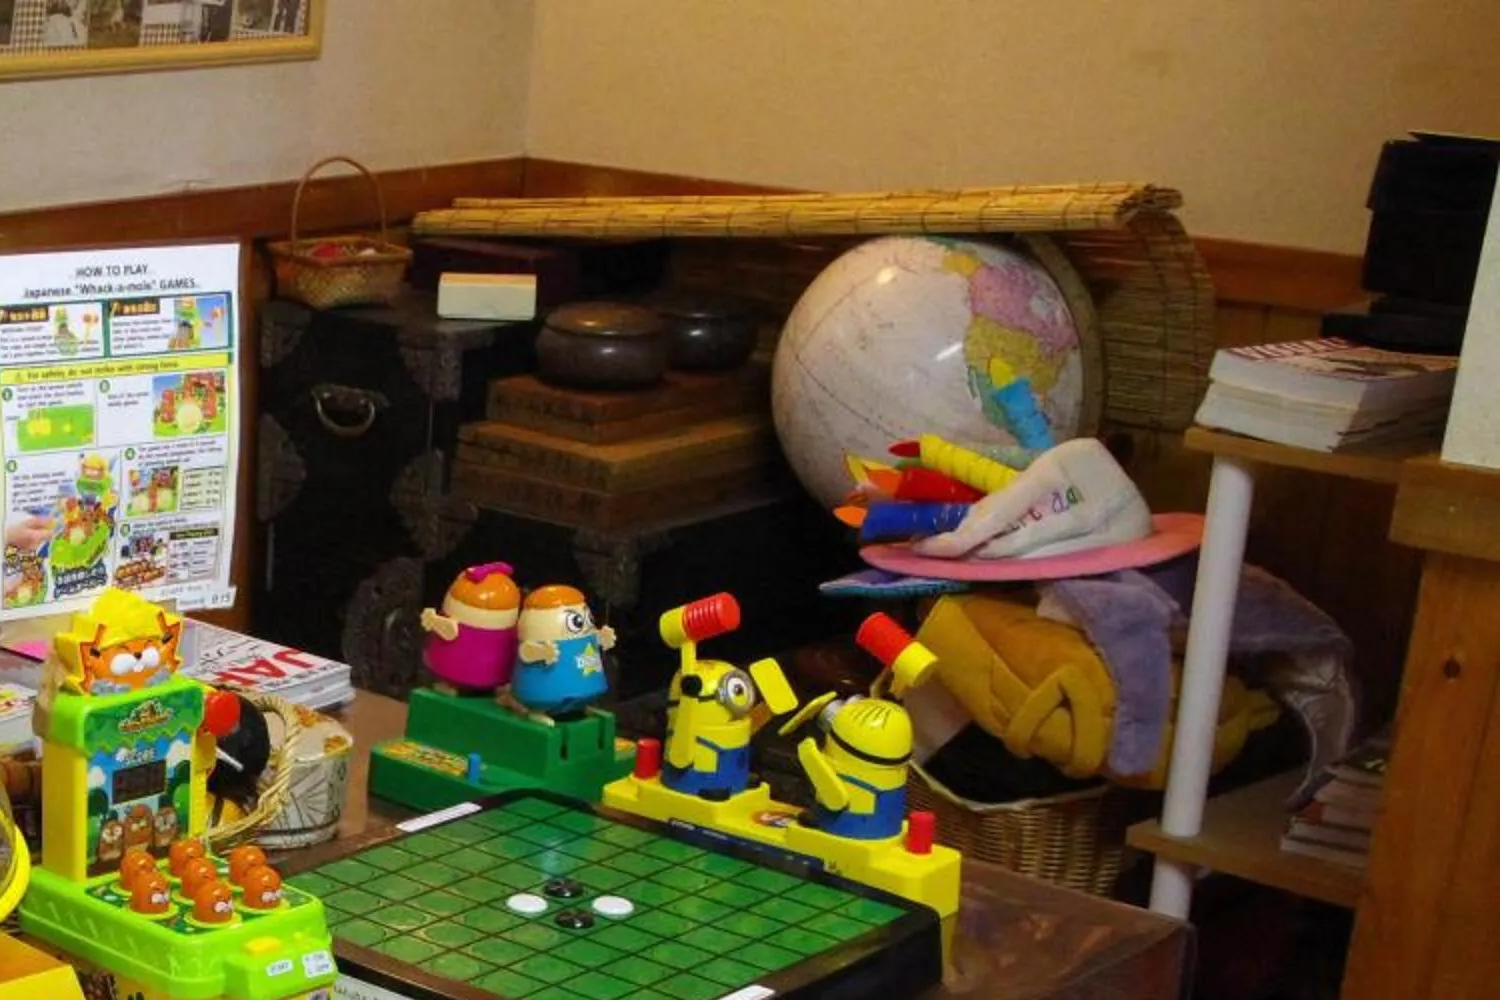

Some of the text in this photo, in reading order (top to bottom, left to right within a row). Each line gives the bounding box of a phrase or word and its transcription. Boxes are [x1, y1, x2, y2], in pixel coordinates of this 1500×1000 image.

[76, 264, 149, 278] HOW TO PLAY
